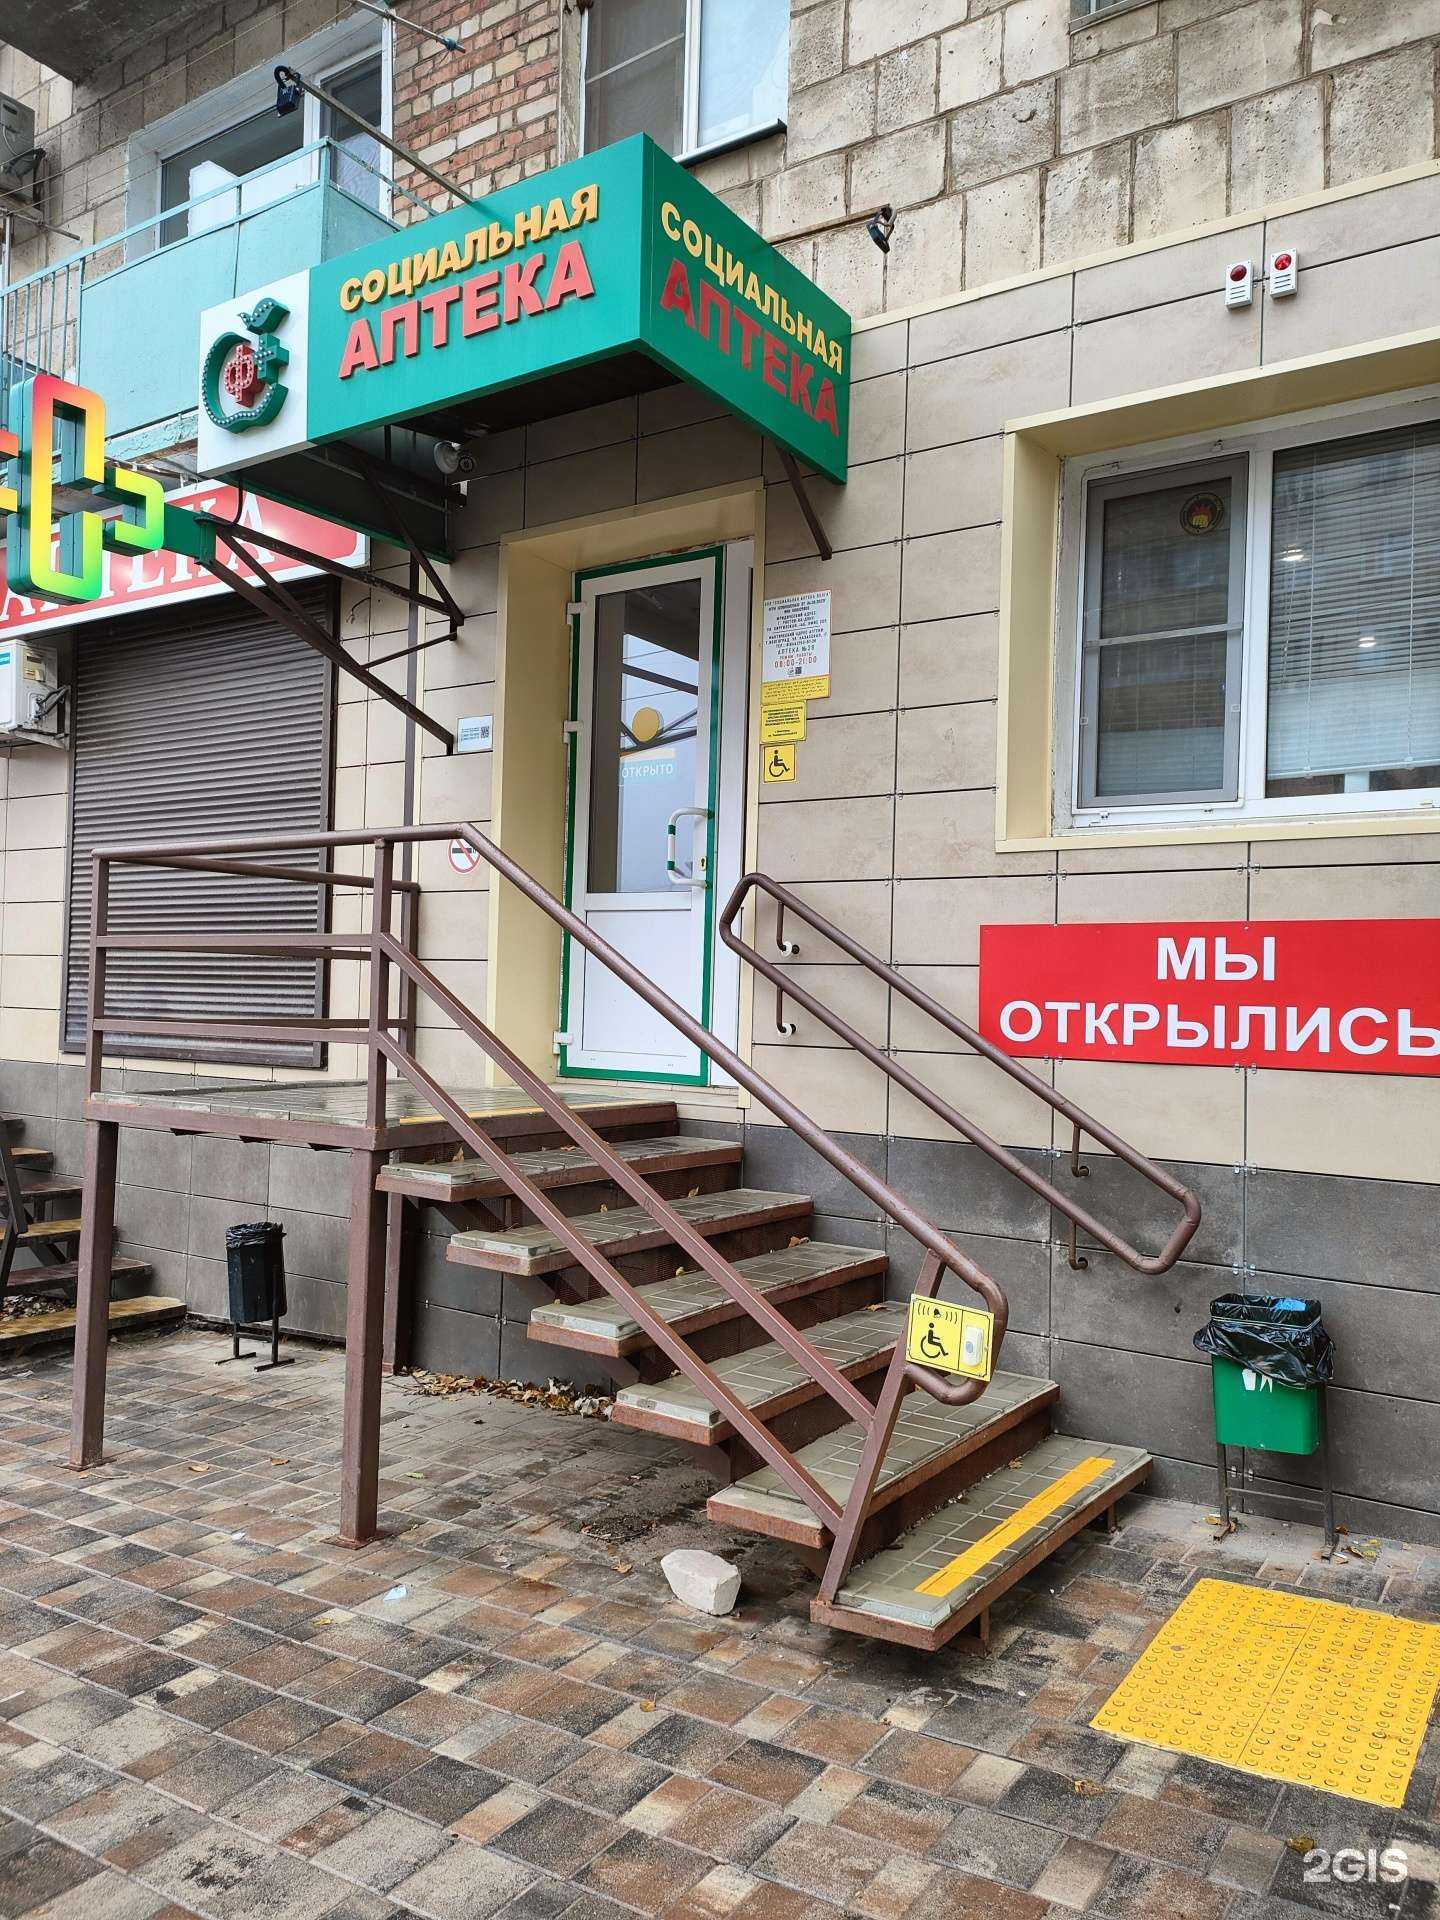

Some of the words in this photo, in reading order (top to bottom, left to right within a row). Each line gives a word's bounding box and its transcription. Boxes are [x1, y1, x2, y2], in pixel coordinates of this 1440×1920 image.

[339, 184, 599, 312] СОЦИАЛЬНАЯ
[339, 240, 596, 380] АПТЕКА
[661, 201, 843, 375] СОЦИАЛЬНАЯ
[660, 258, 840, 437] АПТЕКА
[0, 489, 275, 621] ЕКА
[621, 764, 673, 778] ОТКРЫТО
[1157, 936, 1276, 981] МЫ
[999, 1000, 1440, 1057] ОТКРЫЛИСЬ
